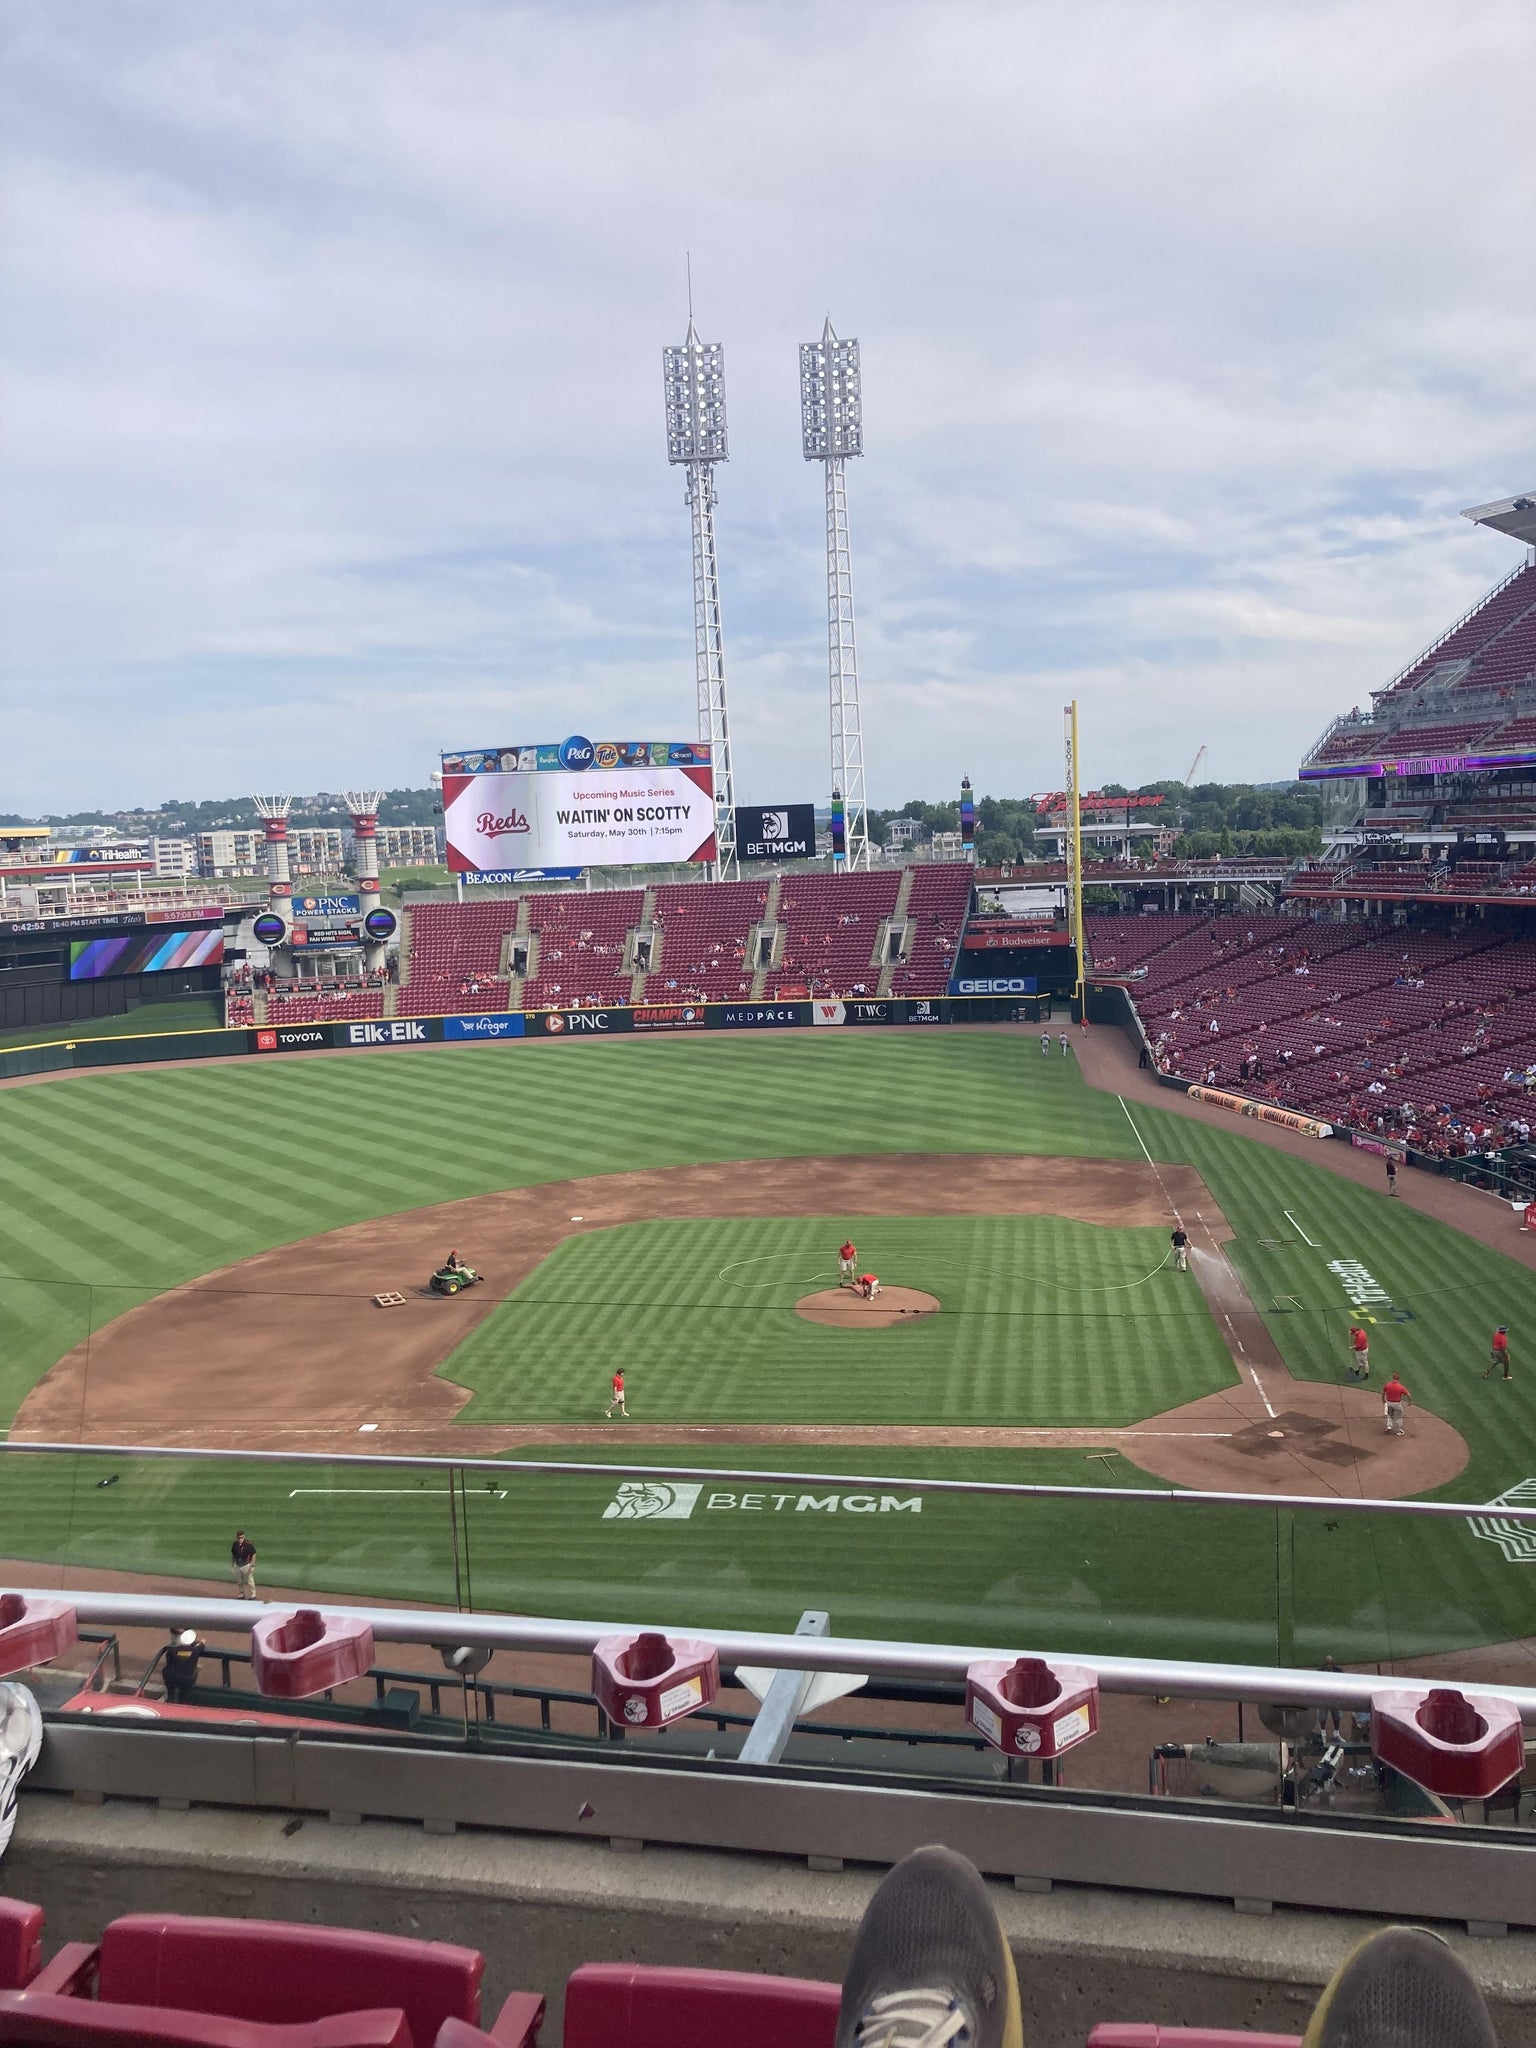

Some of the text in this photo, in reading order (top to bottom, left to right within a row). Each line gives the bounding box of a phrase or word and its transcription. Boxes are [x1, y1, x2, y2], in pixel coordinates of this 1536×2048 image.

[567, 747, 592, 760] P&G
[597, 749, 617, 764] Tide
[1401, 757, 1467, 774] COMMUNITY NIGHT
[573, 788, 675, 801] Upcoming Music Series
[557, 806, 691, 824] WAITIN' ON SCOTTY
[476, 808, 531, 839] Reds
[568, 828, 647, 838] Saturday, May 30th
[655, 827, 683, 837] 7:15pm
[100, 849, 142, 860] TriHealth
[747, 841, 806, 855] BETMGM
[466, 872, 512, 884] BEACON
[318, 897, 348, 908] PNC
[12, 922, 46, 932] 0:42:52
[1002, 937, 1051, 946] Budweiser
[959, 979, 1025, 993] GEICO
[726, 1010, 794, 1022] MEDPACE
[854, 1004, 887, 1017] TWC
[476, 1017, 509, 1036] Kroger
[567, 1013, 609, 1030] PNC
[280, 1032, 323, 1043] TOYOTA
[1326, 1259, 1393, 1305] TriHealth
[706, 1493, 923, 1512] BETMGM
